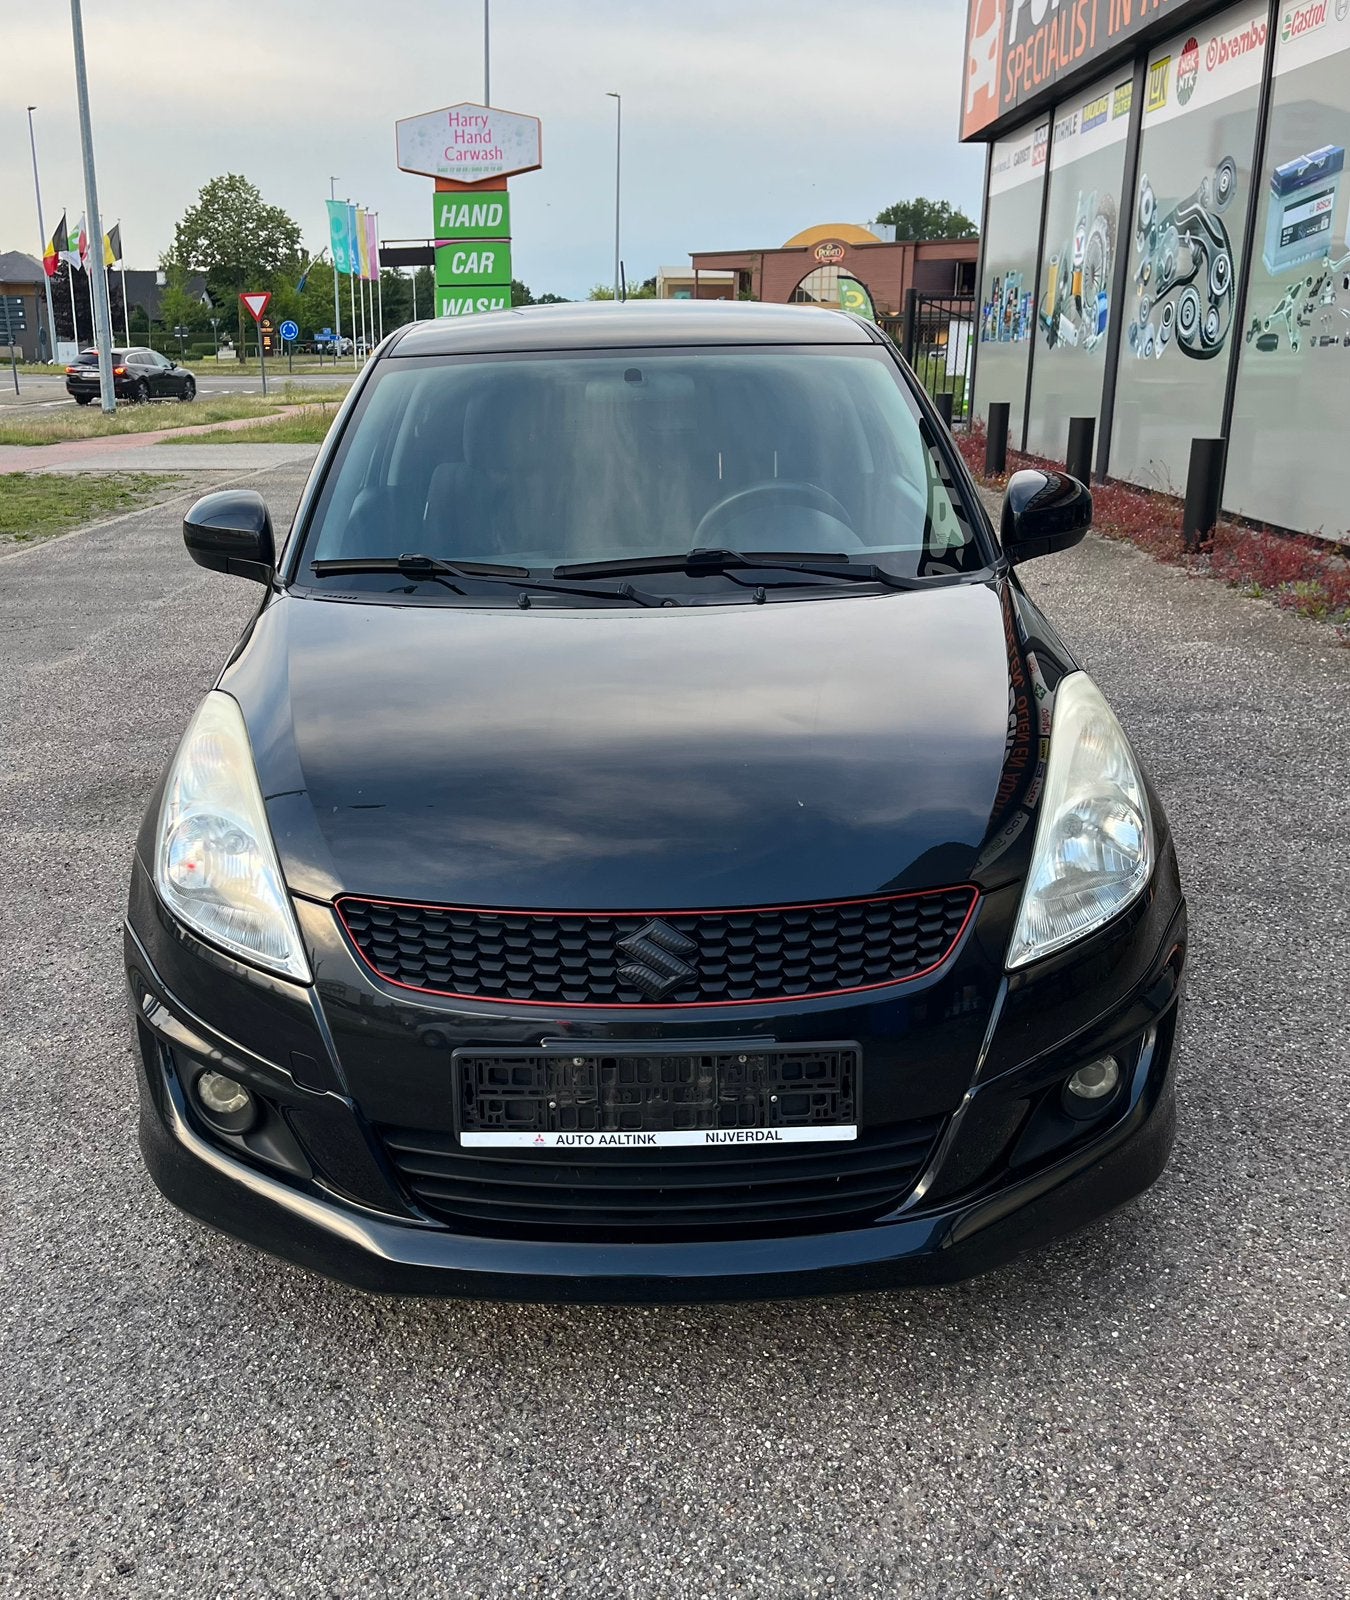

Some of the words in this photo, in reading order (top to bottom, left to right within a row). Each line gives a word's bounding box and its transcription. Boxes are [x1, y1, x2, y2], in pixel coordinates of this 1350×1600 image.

[1291, 0, 1327, 37] Castrol
[1004, 0, 1097, 103] SPECIALIST
[1218, 20, 1268, 64] brembo
[448, 112, 489, 129] Harry
[454, 129, 492, 144] Hand
[444, 145, 503, 161] Carwash
[440, 203, 503, 228] HAND
[451, 251, 495, 275] CAR
[556, 1134, 594, 1145] AUTO
[598, 1134, 657, 1145] AALTINK
[705, 1130, 783, 1143] NIJVERDAL
